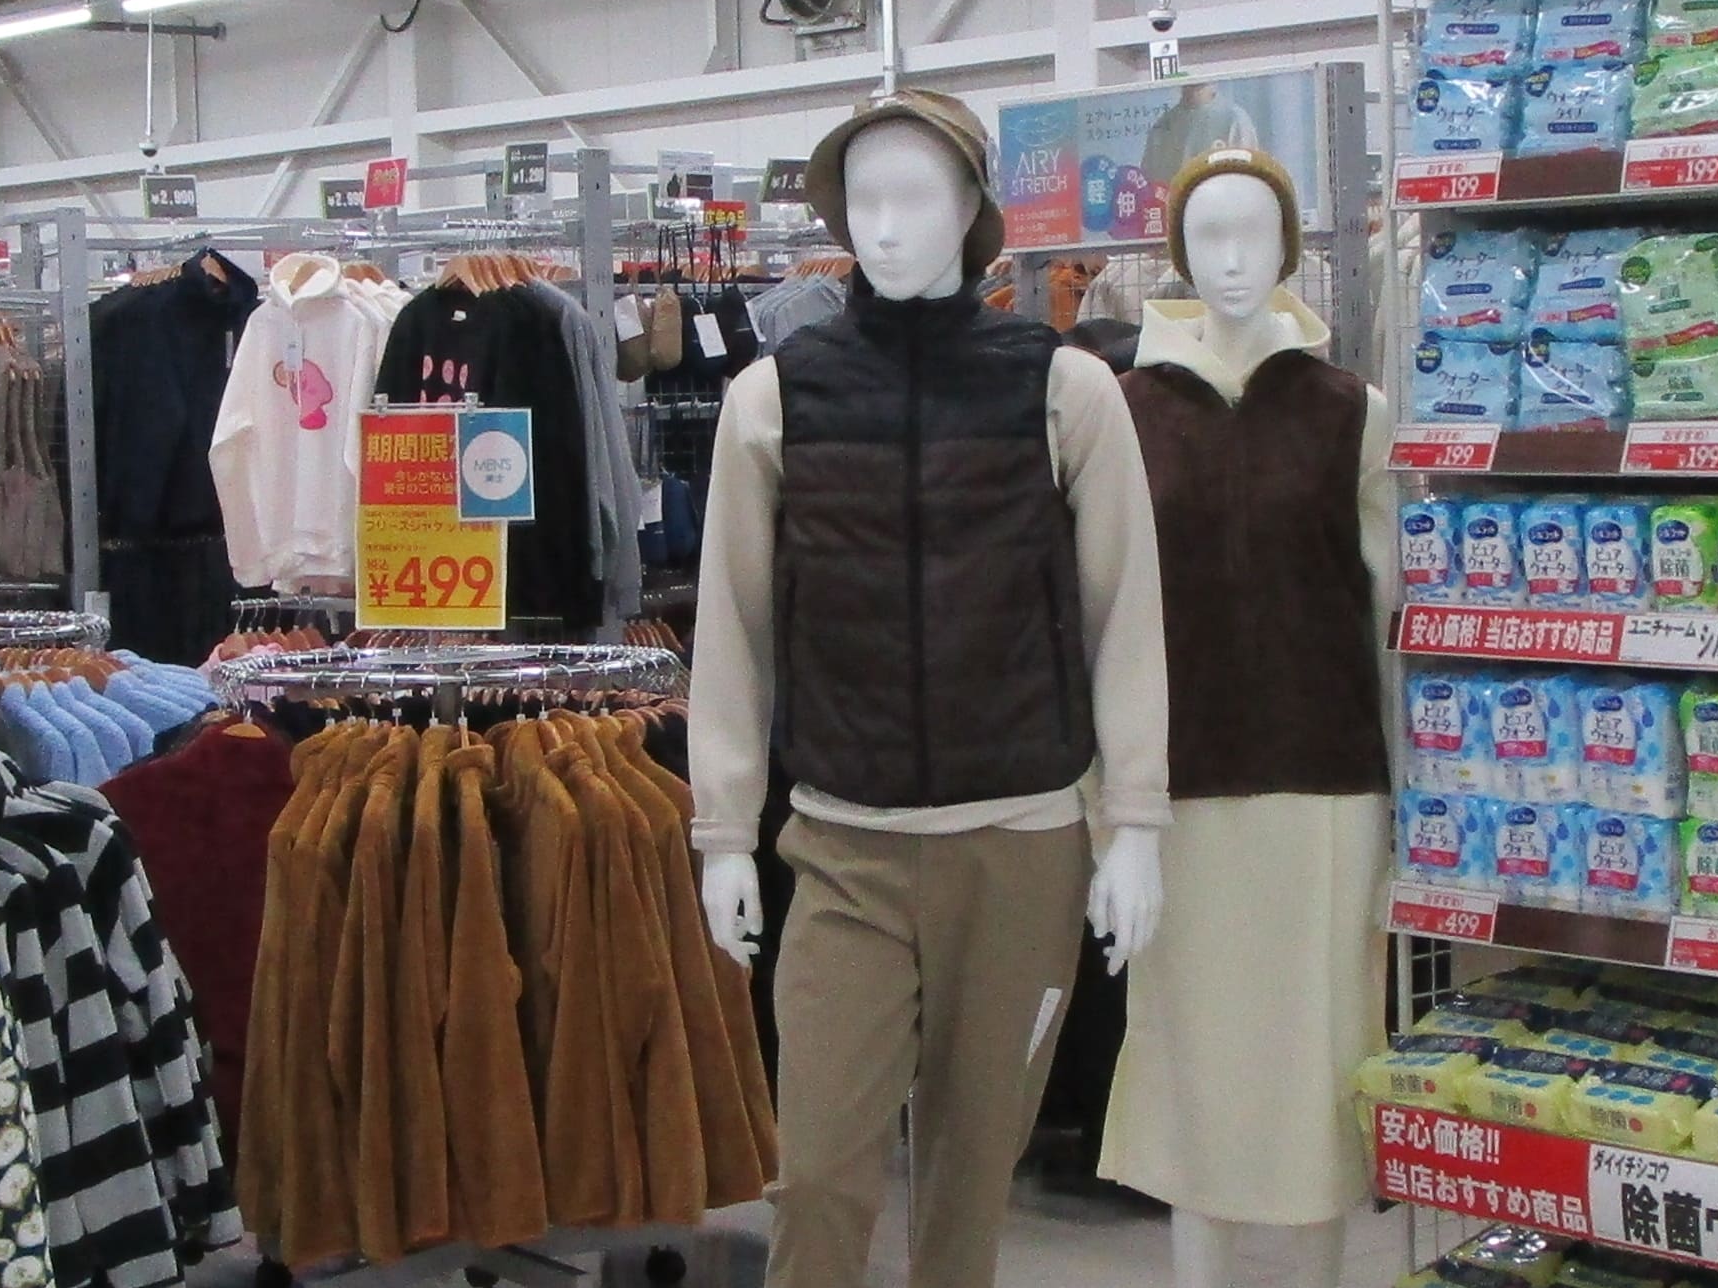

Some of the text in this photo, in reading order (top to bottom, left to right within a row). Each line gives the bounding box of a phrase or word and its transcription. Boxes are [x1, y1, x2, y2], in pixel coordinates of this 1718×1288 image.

[1016, 149, 1060, 175] AIRY
[1011, 175, 1067, 197] STRETCH
[1088, 179, 1107, 205] 軽
[1117, 191, 1136, 218] 伸
[367, 433, 456, 463] 期間限
[1408, 538, 1434, 551] ピュア
[1470, 542, 1496, 556] ピュア
[1534, 548, 1562, 561] ピュア
[1595, 547, 1623, 561] ピュア
[1405, 553, 1444, 568] ウォーター
[1468, 557, 1509, 572] ウォーター
[1529, 561, 1574, 576] ウォーター
[1591, 561, 1634, 575] ウォーター
[1660, 559, 1690, 577] 除菌
[368, 556, 495, 609] ¥499
[1410, 612, 1614, 656] 安心価格! 当店おすすめ商品
[1626, 619, 1698, 637] ユニチャーム
[1381, 1108, 1501, 1164] 安心価格!!
[1593, 1149, 1670, 1182] ダイイチシコウ
[1384, 1160, 1588, 1234] 当店おすすめ商品
